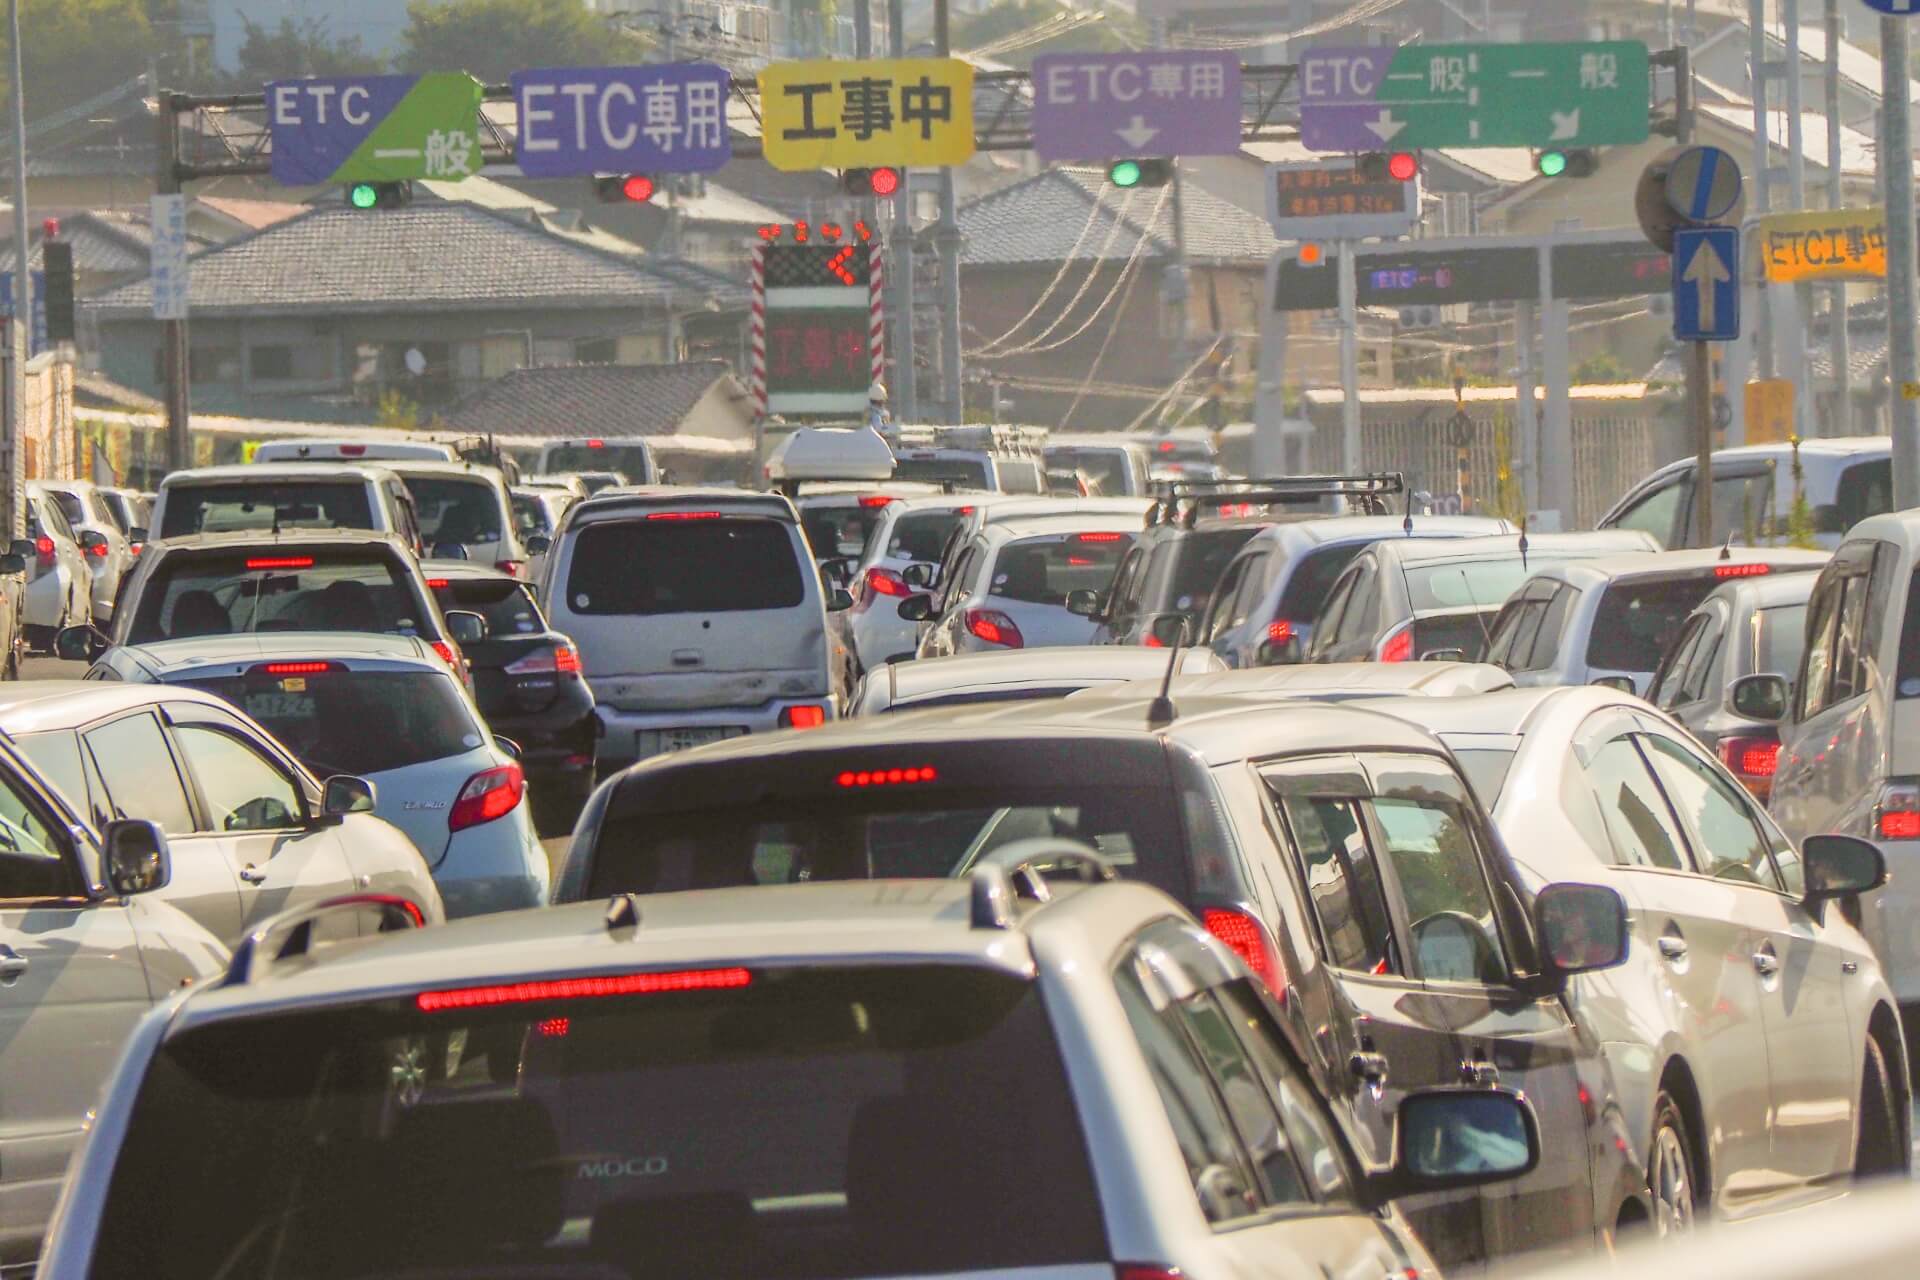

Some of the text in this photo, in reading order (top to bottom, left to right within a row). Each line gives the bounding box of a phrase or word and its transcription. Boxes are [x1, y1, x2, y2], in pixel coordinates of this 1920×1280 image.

[1046, 62, 1225, 104] ETC専用
[1304, 55, 1466, 96] ETC 一般
[275, 86, 371, 125] ETC
[522, 79, 722, 153] ETC専用
[783, 76, 953, 140] 工事中
[373, 129, 473, 176] 一般
[578, 1157, 668, 1178] MOCO
